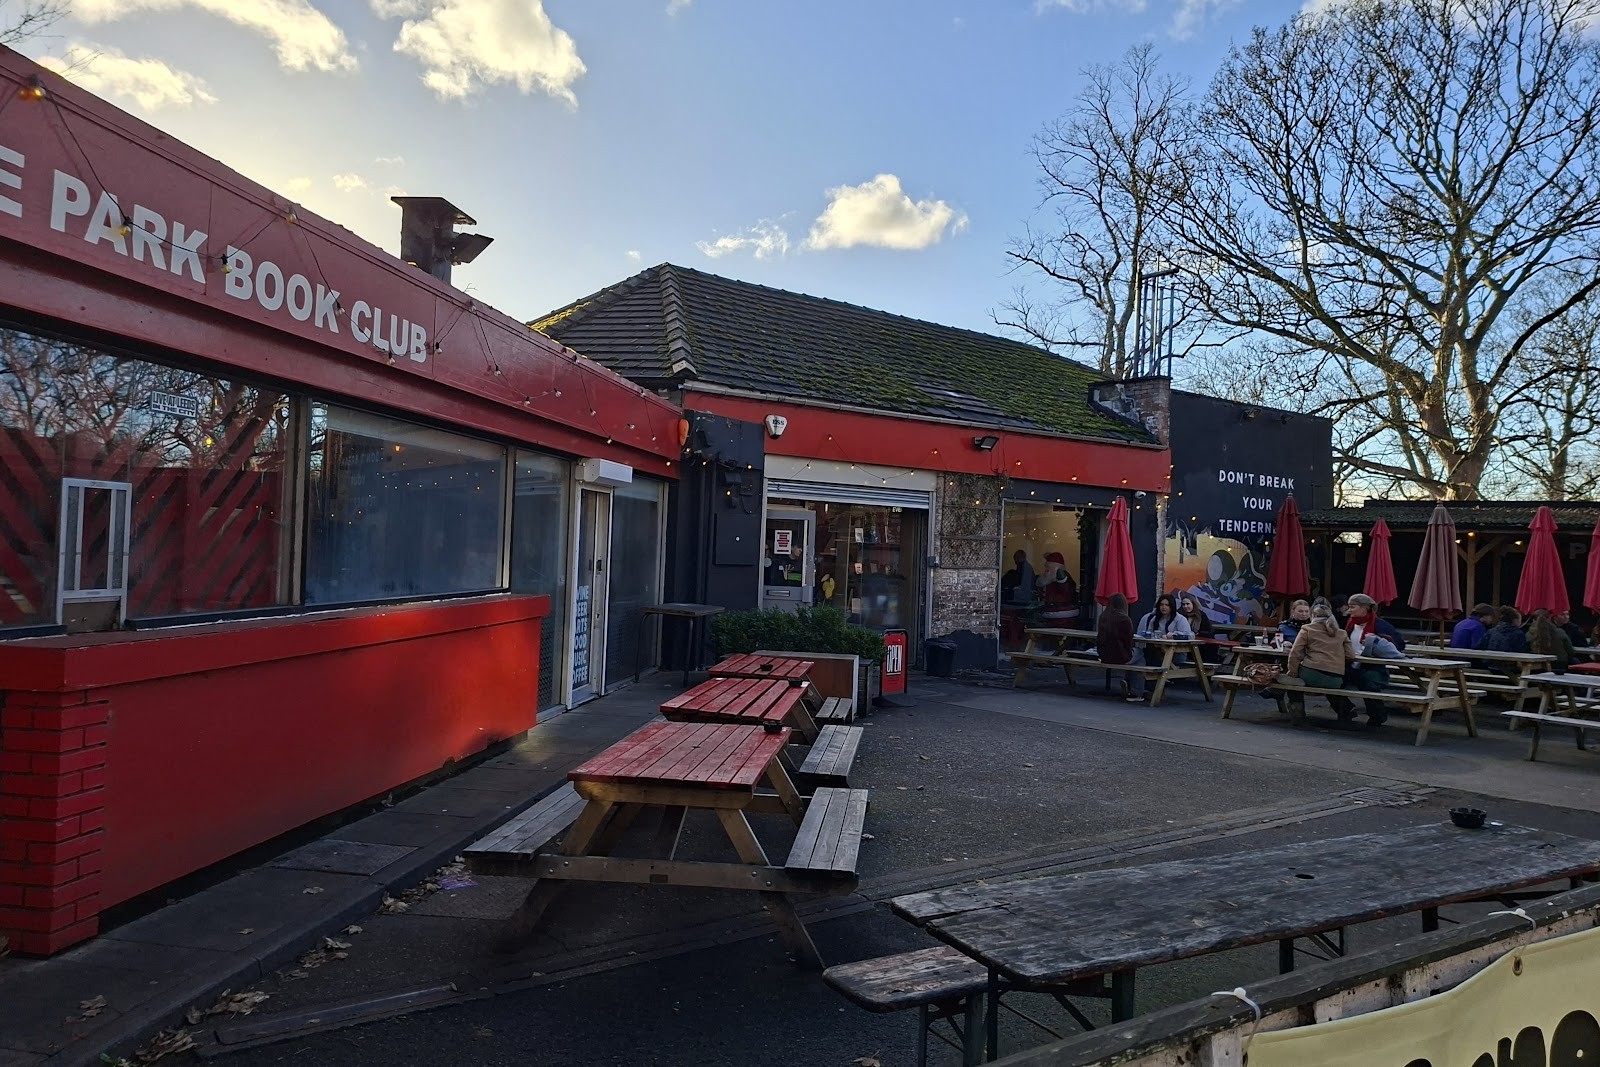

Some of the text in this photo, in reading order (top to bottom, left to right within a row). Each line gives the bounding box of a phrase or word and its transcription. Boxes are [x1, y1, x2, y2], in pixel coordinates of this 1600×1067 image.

[50, 169, 208, 284] PARK
[225, 245, 340, 334] BOOK
[351, 301, 427, 363] CLUB
[152, 391, 196, 411] LIVE AT LEEDS
[162, 405, 177, 413] THE
[178, 408, 195, 416] CITY
[1219, 469, 1295, 490] DON'T BREAK
[1242, 496, 1272, 511] YOUR
[577, 601, 588, 617] EER
[576, 617, 588, 633] RTS
[574, 633, 587, 650] OOD
[573, 650, 587, 667] USIC
[886, 644, 903, 673] OPEN
[572, 665, 588, 684] OFFEE
